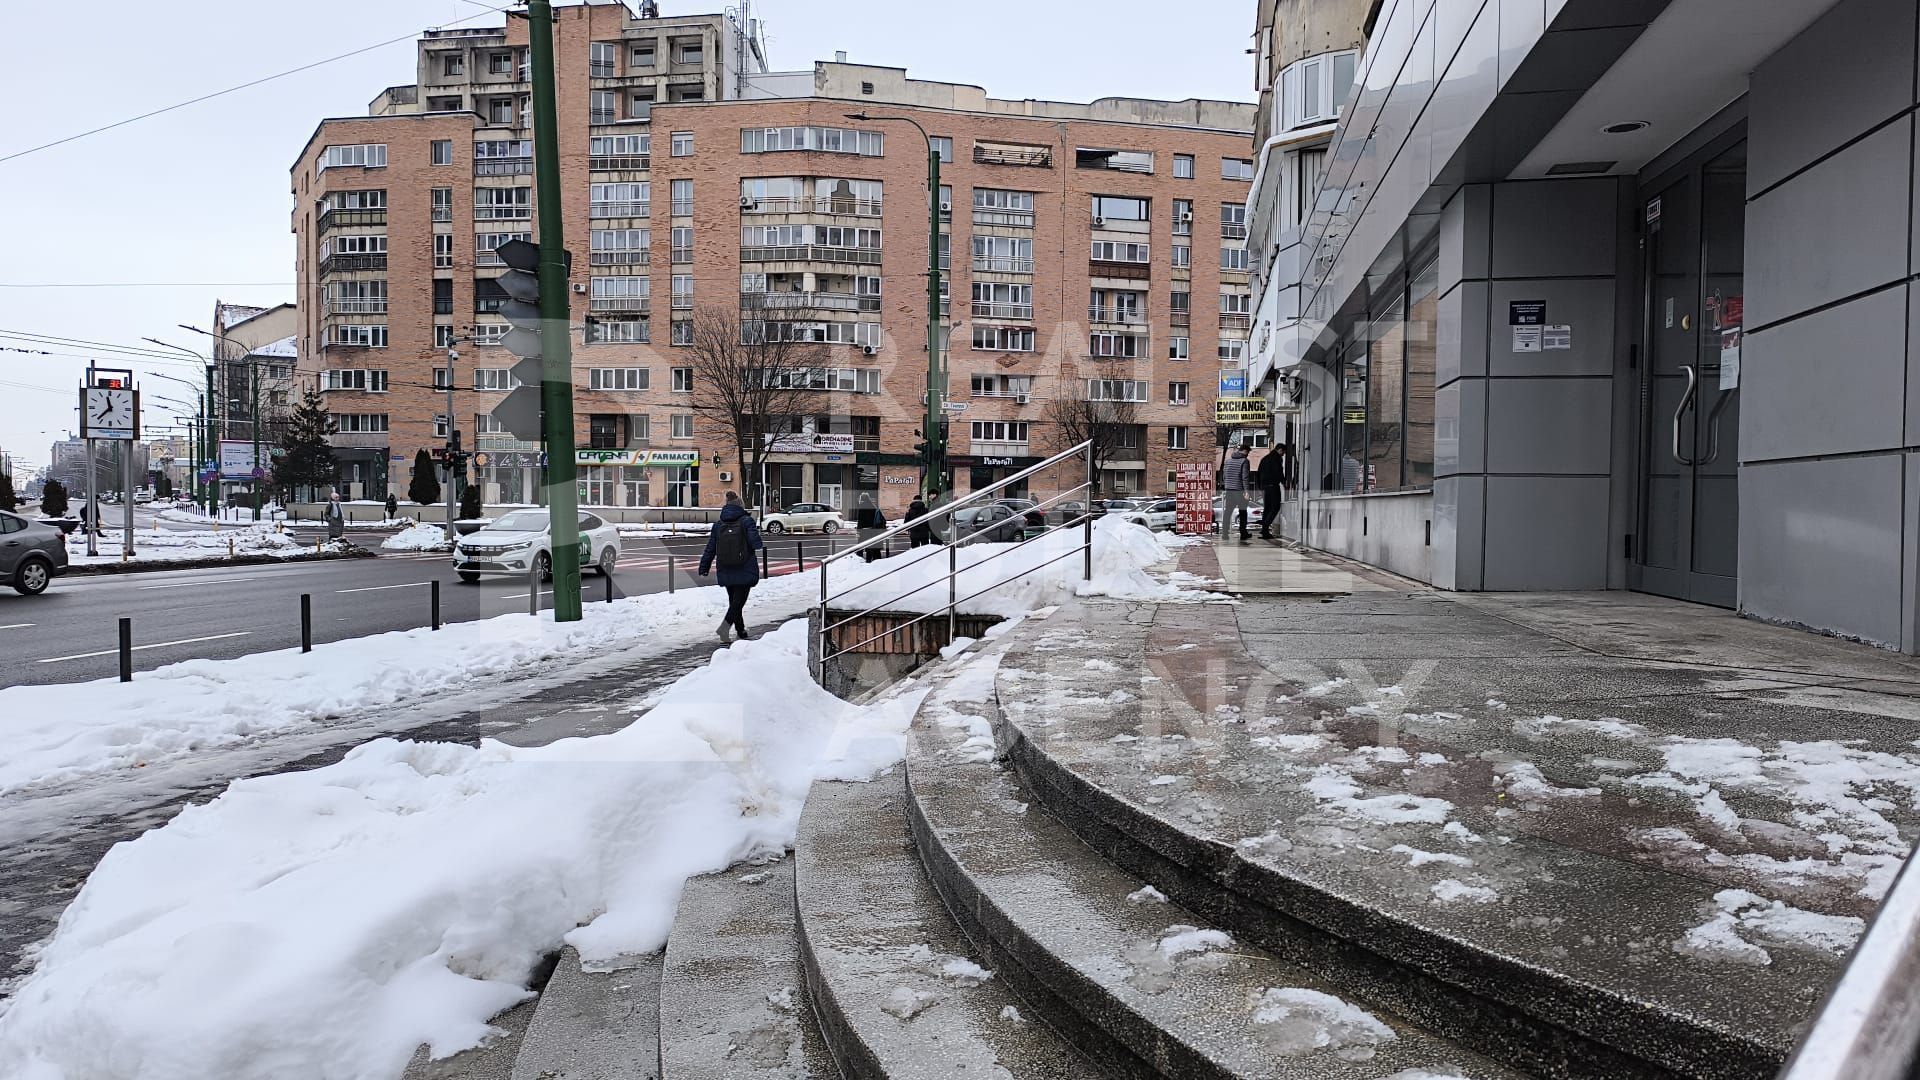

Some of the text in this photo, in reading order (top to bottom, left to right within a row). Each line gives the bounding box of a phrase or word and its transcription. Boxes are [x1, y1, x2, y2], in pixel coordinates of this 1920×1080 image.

[1216, 400, 1266, 412] EXCHANGE
[1216, 413, 1240, 421] SCHIMB
[578, 451, 629, 463] CATENA
[652, 453, 695, 461] FARMACIE
